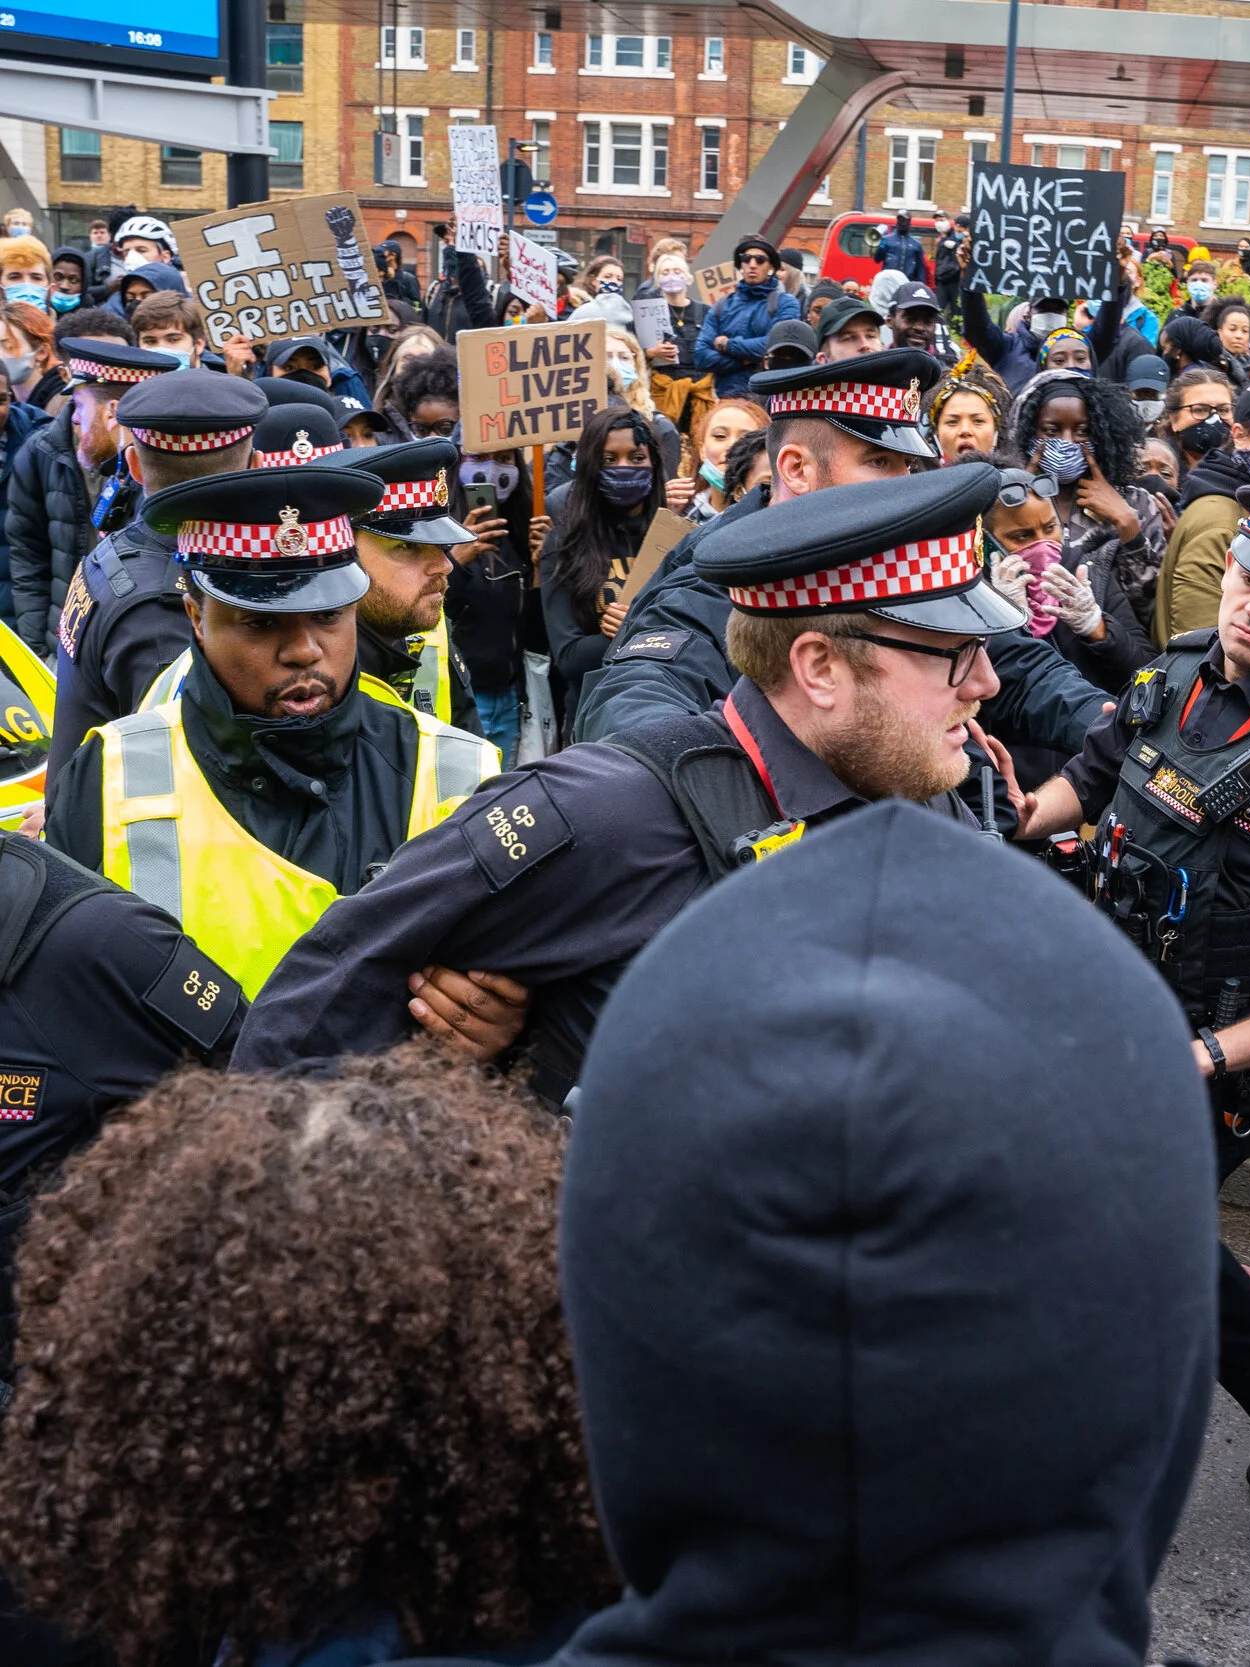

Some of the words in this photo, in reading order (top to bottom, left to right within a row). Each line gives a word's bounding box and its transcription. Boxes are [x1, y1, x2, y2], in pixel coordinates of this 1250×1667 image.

[976, 172, 1084, 215] MAKE
[203, 213, 283, 277] I
[460, 222, 500, 252] RACIST
[975, 208, 1112, 252] AFRICA
[973, 238, 1104, 275] GREAT
[197, 260, 333, 311] CAN'T
[969, 262, 1113, 301] AGAIN!
[205, 285, 384, 348] BREATHE
[640, 304, 667, 318] JUST
[485, 333, 594, 377] BLACK
[499, 366, 591, 407] LIVES
[479, 398, 599, 443] MATTER
[485, 806, 527, 860] 1218SC
[512, 805, 536, 827] CP
[183, 970, 202, 996] CP
[197, 980, 221, 1011] 858
